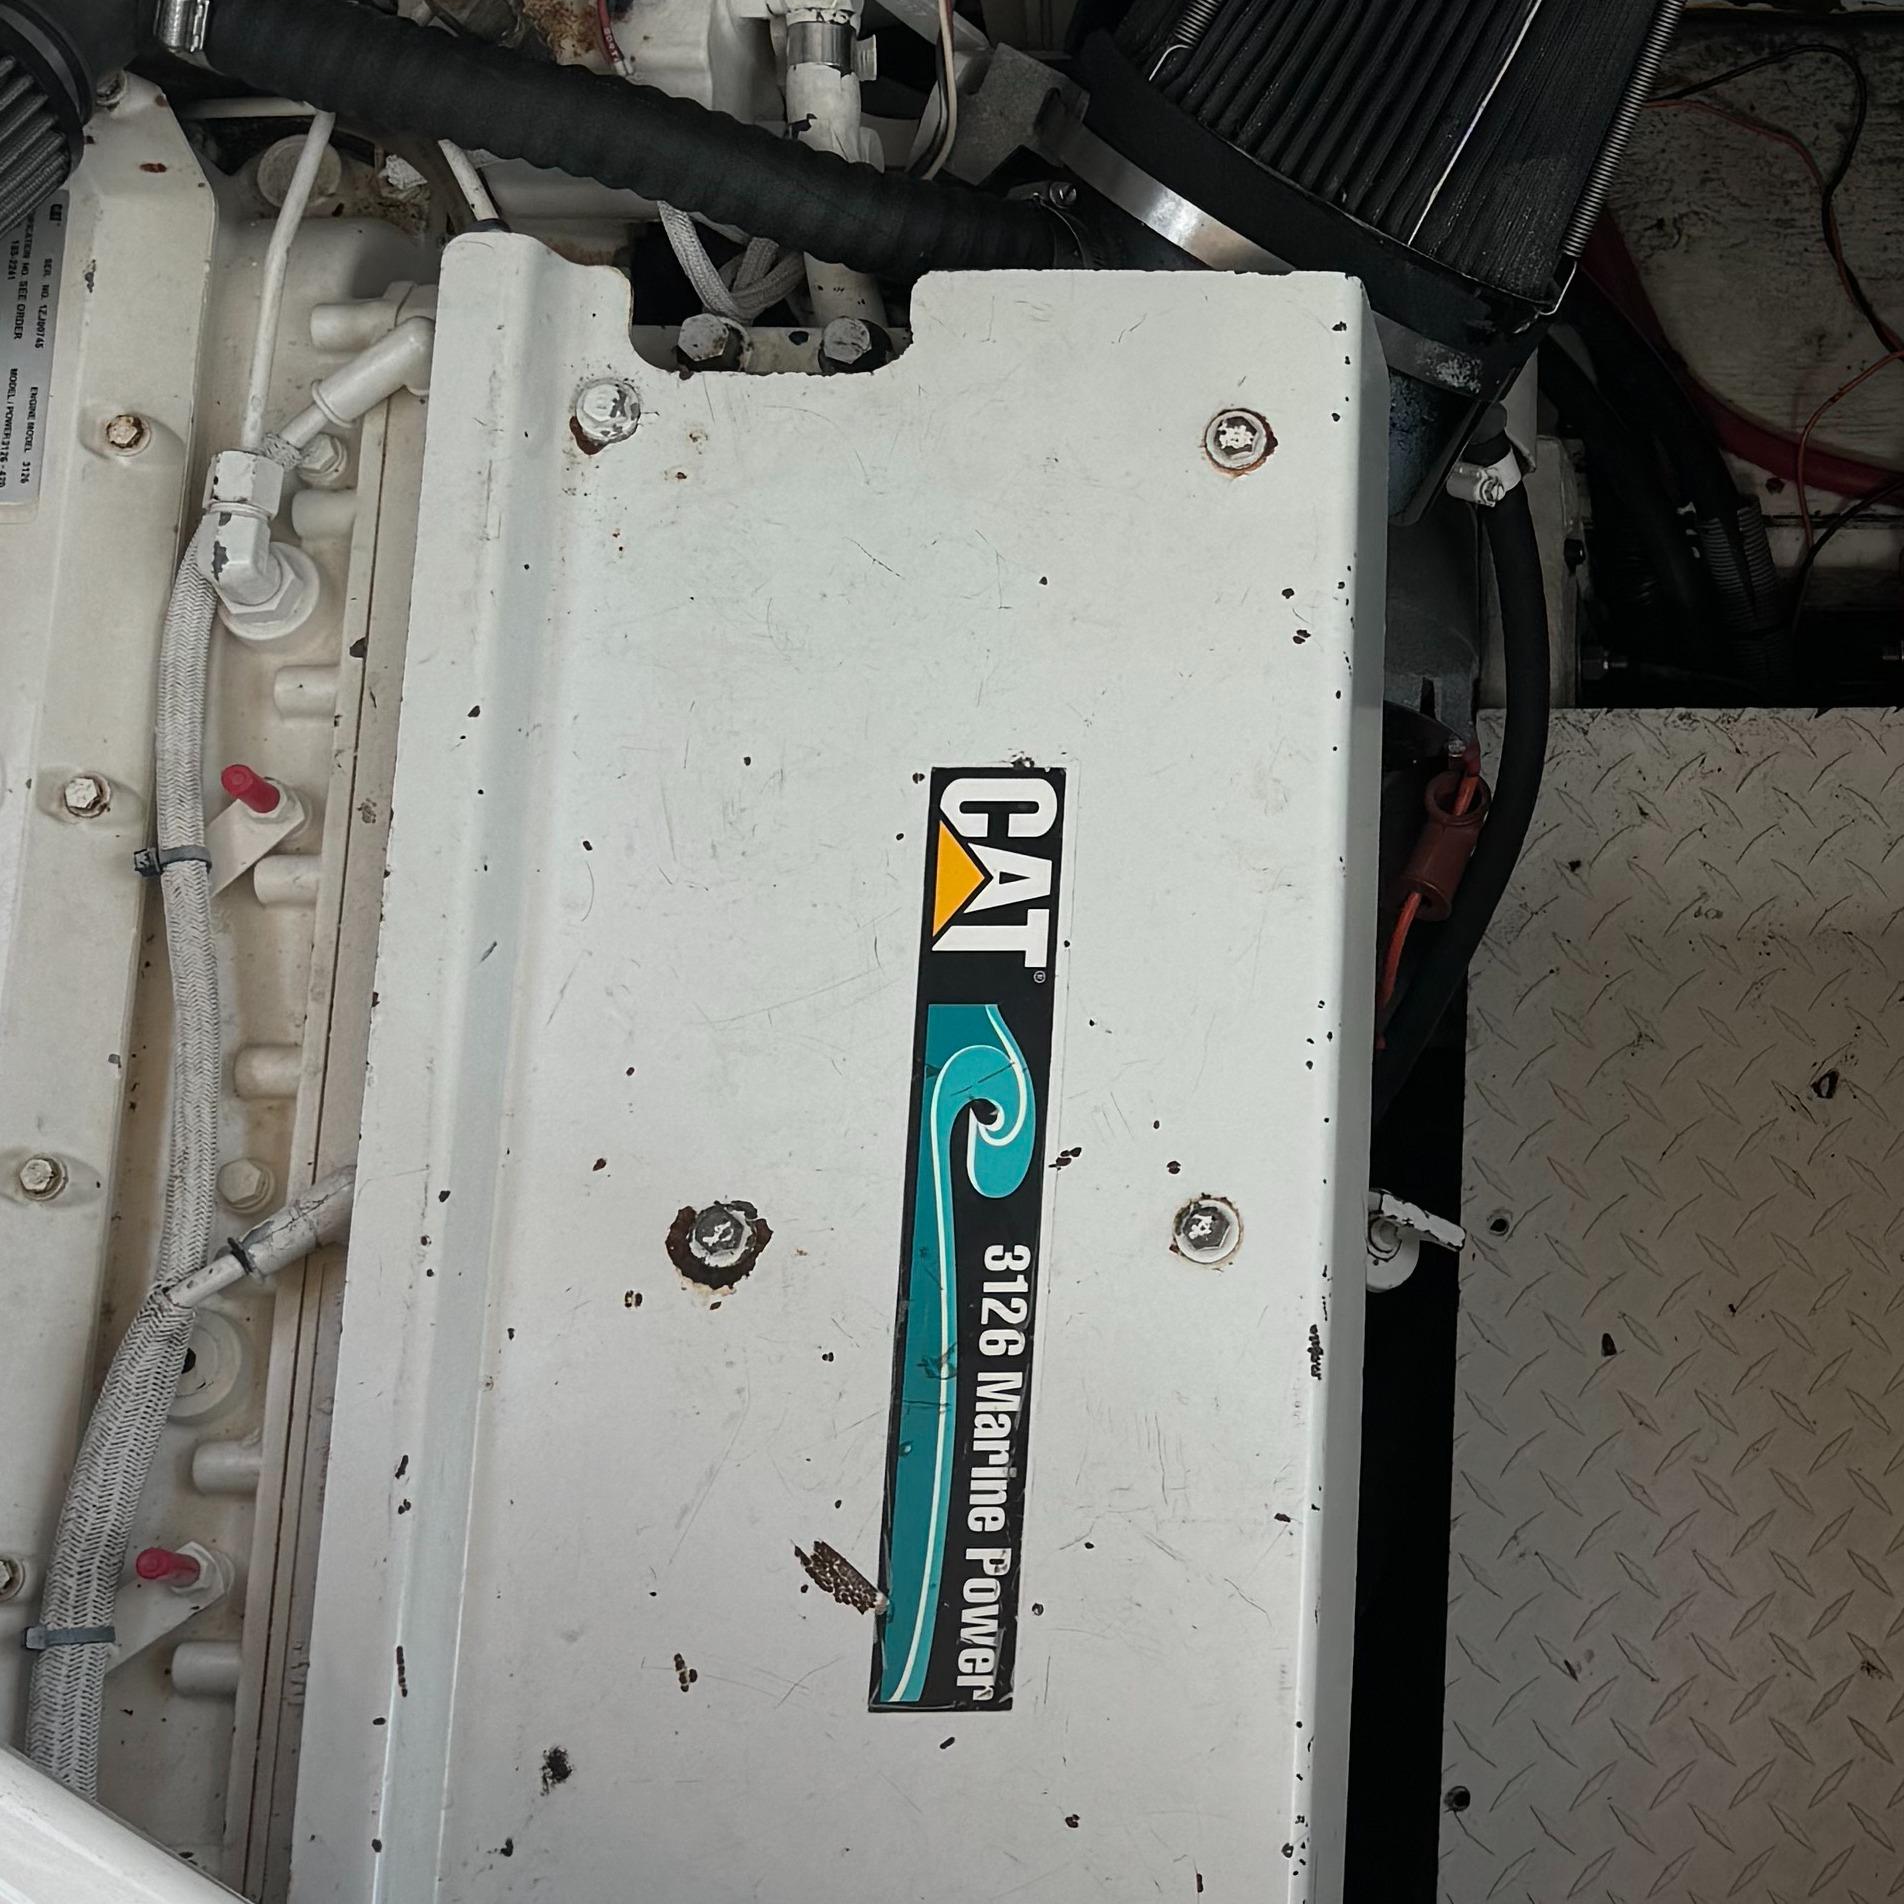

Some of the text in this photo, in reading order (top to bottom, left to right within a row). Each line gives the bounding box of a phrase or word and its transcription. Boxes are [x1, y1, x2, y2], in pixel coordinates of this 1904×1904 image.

[14, 304, 26, 340] ORDER
[7, 368, 18, 400] MODEL
[931, 777, 1058, 968] CAT
[956, 1243, 1030, 1702] 3126 Marine Power
